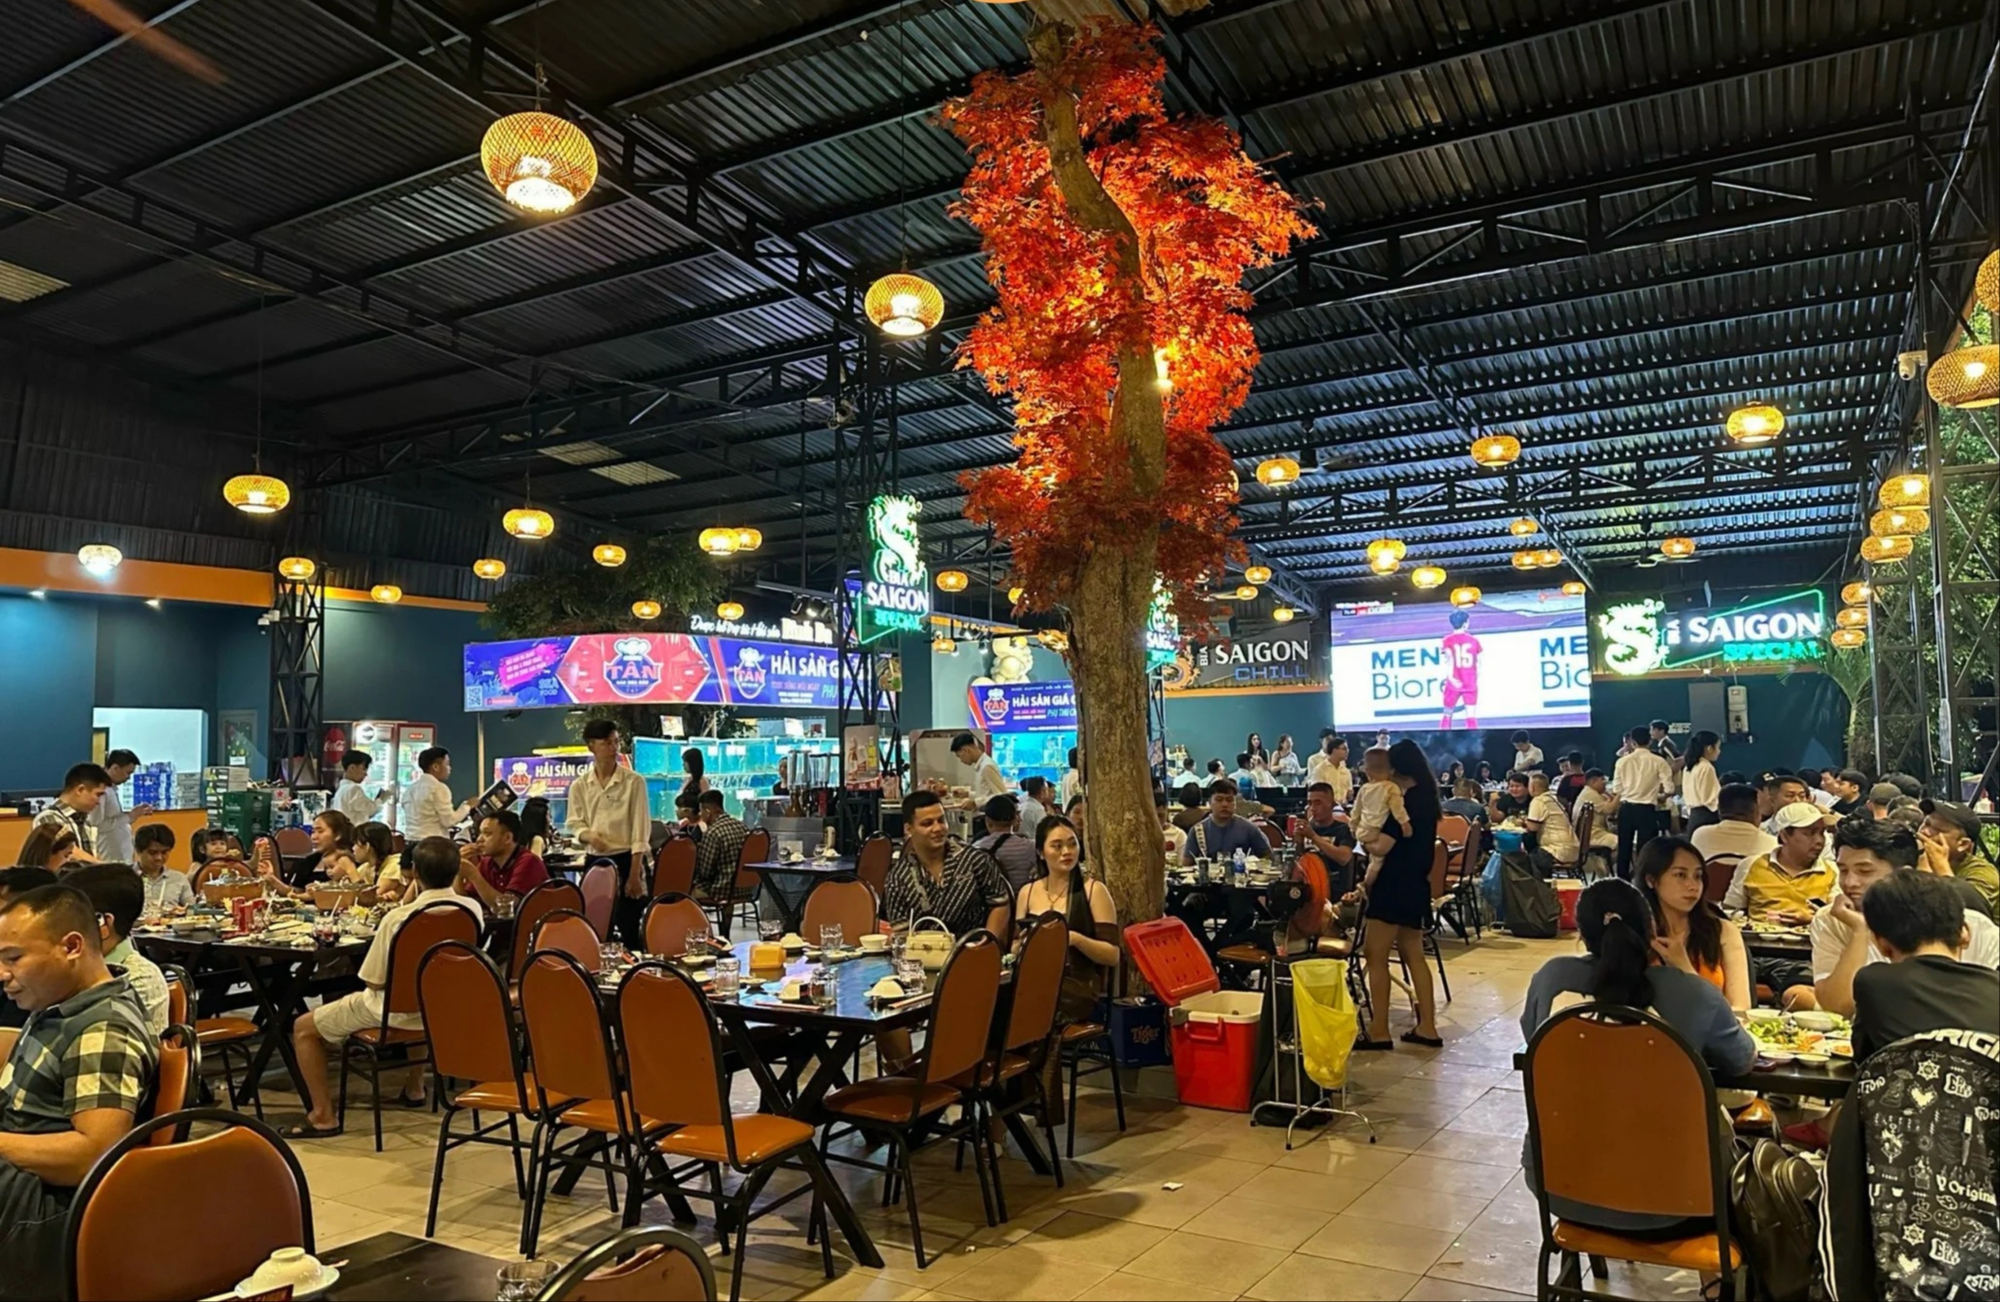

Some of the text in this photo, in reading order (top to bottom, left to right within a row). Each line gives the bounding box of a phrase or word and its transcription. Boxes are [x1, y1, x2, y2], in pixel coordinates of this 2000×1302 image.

[866, 581, 929, 612] SAIGON
[1688, 612, 1821, 643] SAIGON
[1215, 640, 1308, 665] SAIGON
[1371, 647, 1440, 669] MEN
[1454, 643, 1473, 668] 15
[606, 661, 657, 681] TÂN
[771, 650, 796, 676] HẢI
[798, 652, 827, 678] SẢN
[1234, 665, 1308, 681] CHILL
[737, 668, 763, 683] TÂN
[1012, 693, 1029, 708] HẢI
[1030, 692, 1051, 707] SẢN
[1052, 692, 1070, 706] GIÁ
[535, 761, 554, 778] HẢI
[554, 761, 575, 777] SẢN
[1131, 1025, 1160, 1044] Tiger
